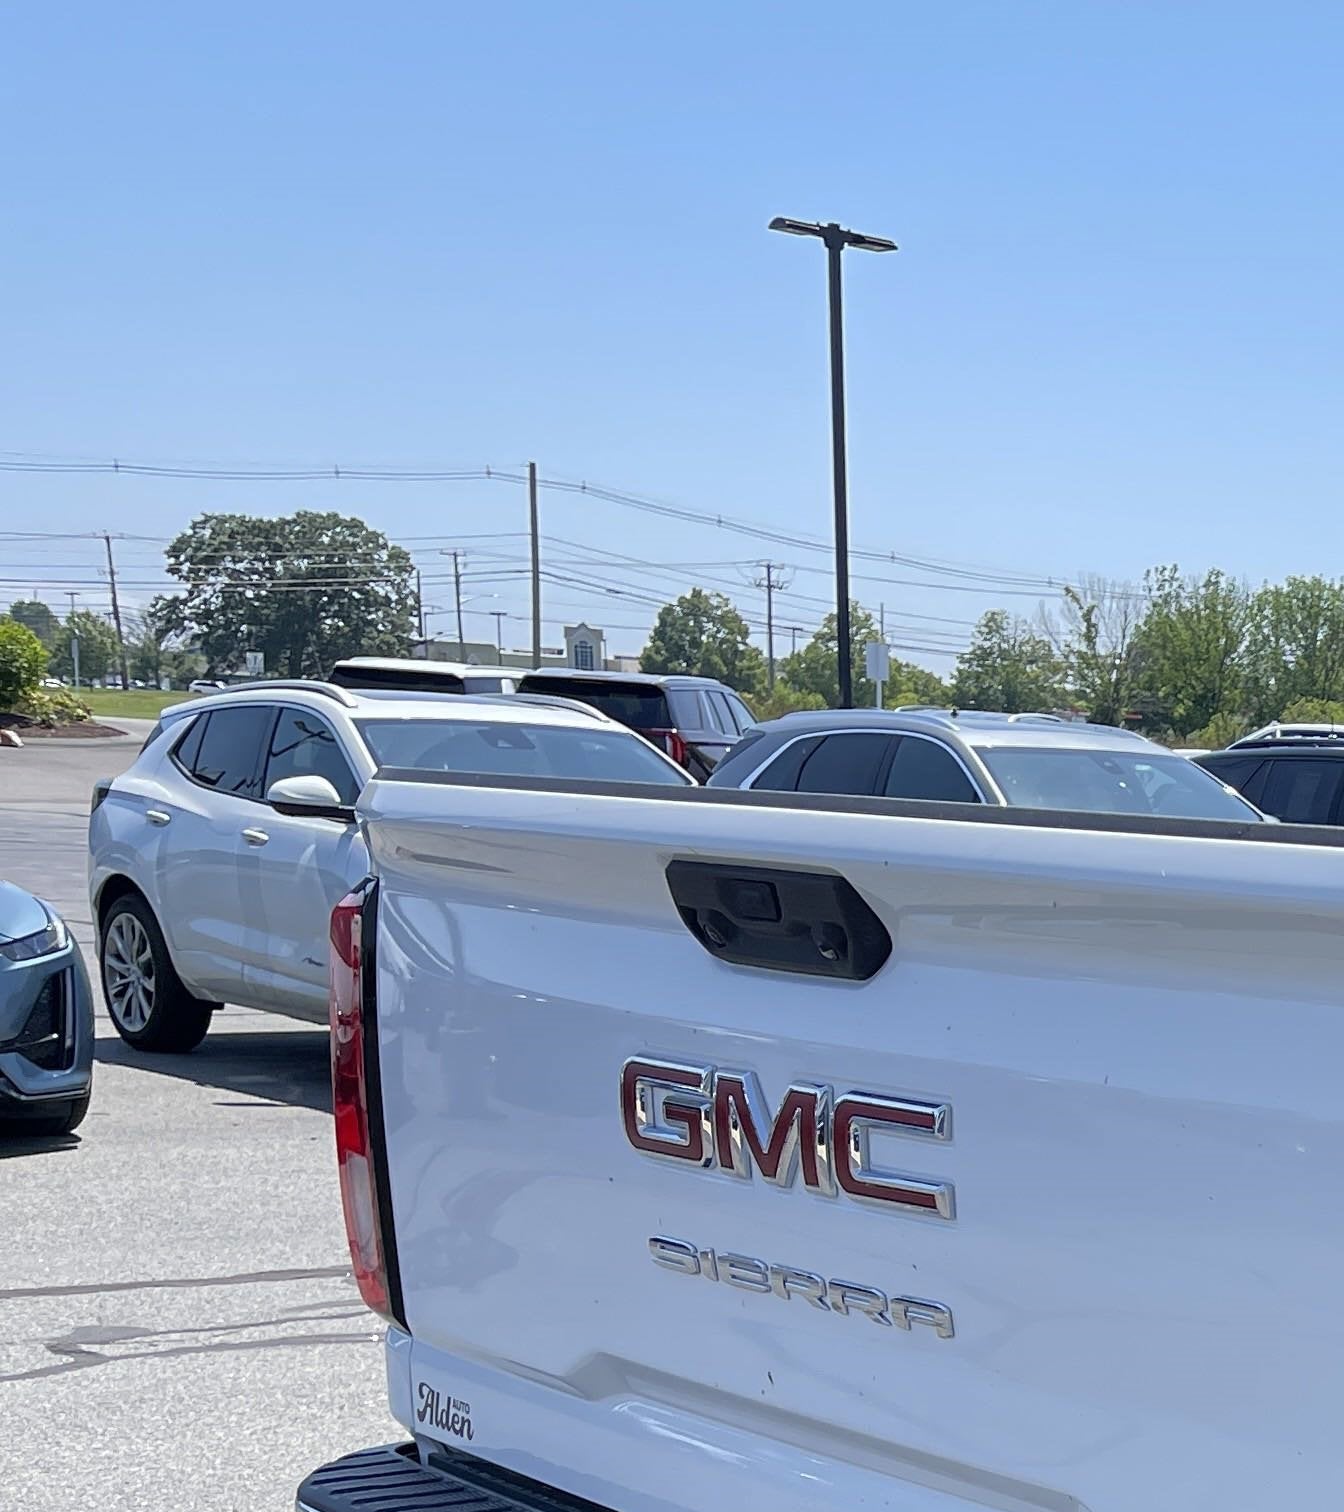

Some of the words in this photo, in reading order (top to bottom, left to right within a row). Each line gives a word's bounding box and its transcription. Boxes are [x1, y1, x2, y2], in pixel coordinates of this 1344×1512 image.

[620, 1054, 957, 1221] GMC
[648, 1235, 956, 1339] SIERRA
[417, 1382, 475, 1441] Alden
[452, 1398, 471, 1415] AUTO
